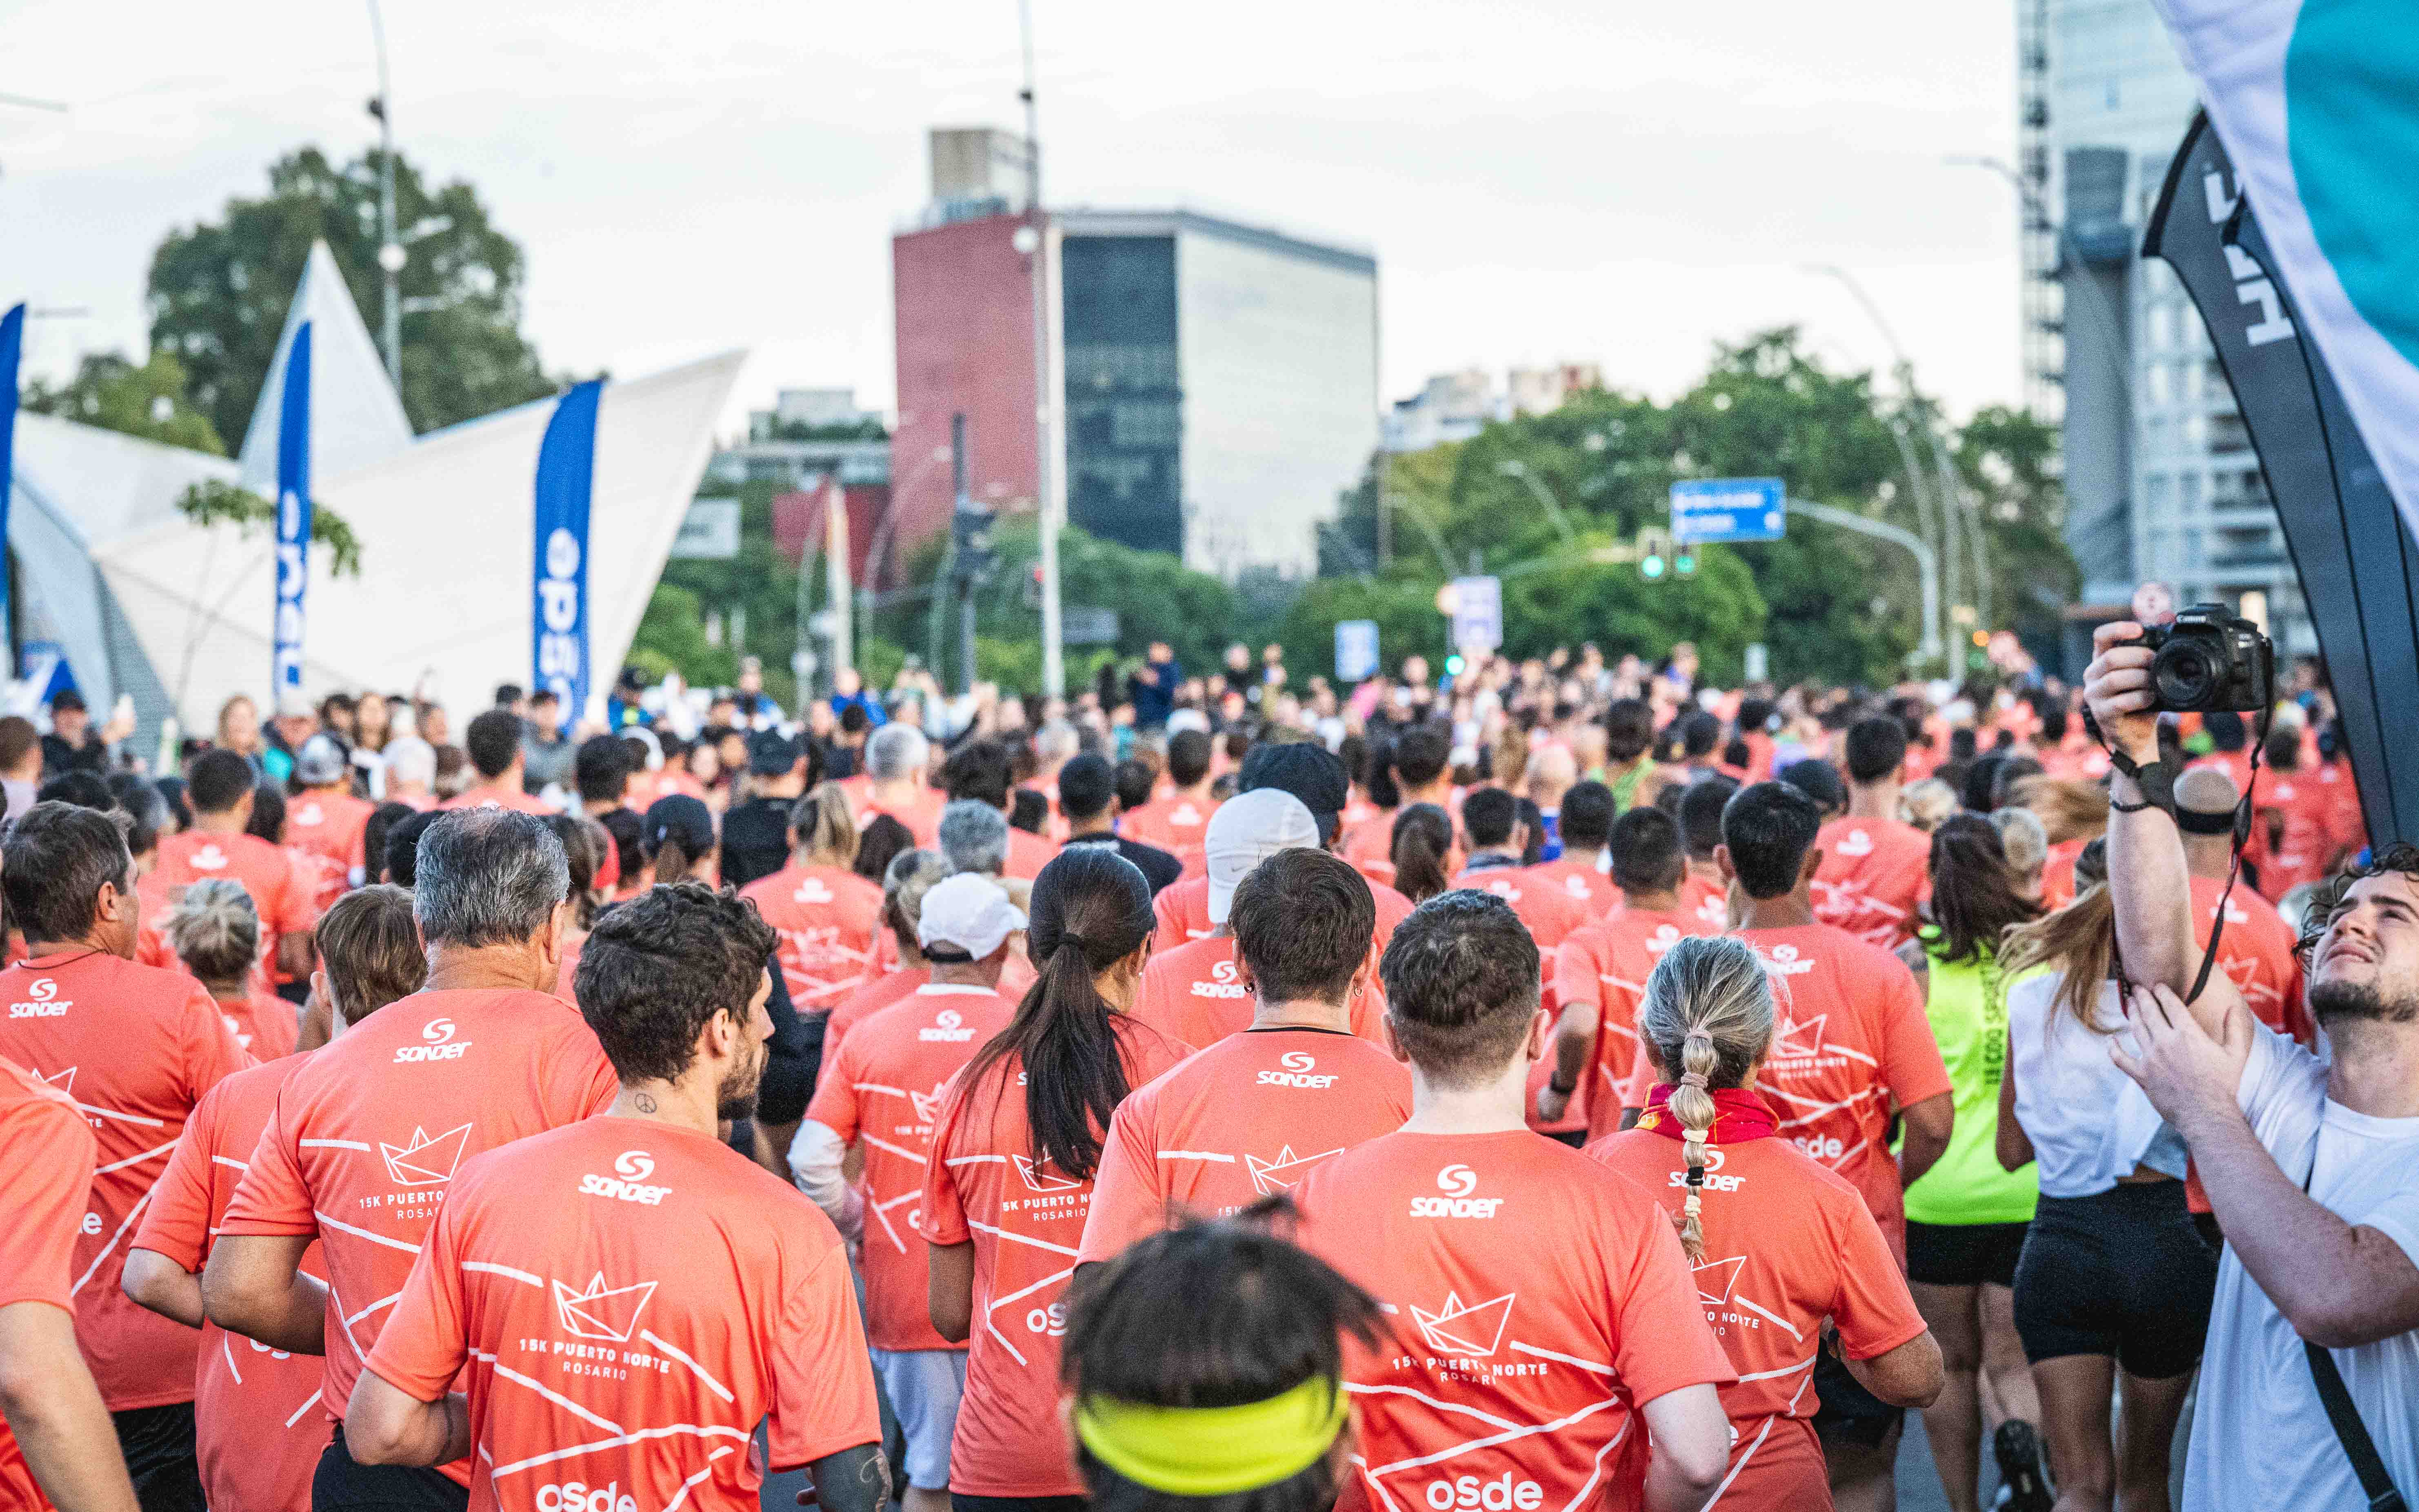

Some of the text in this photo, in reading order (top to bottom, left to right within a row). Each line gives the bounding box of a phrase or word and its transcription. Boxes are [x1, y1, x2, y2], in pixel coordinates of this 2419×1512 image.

[1190, 981, 1245, 999] SONDe
[1794, 1132, 1842, 1158] sde
[359, 1190, 444, 1209] 15K PUERTO
[1024, 1195, 1075, 1209] PUERTO
[397, 1207, 439, 1220] ROSA
[1033, 1208, 1086, 1221] ROSARIO
[1026, 1302, 1066, 1336] os
[519, 1339, 671, 1374] 15K PUERTO NORTE
[563, 1361, 627, 1381] ROSARIO
[1426, 1358, 1488, 1371] PUERT
[1492, 1363, 1548, 1377] NORTE
[1439, 1371, 1496, 1385] ROSARI
[536, 1480, 638, 1512] osde
[1426, 1471, 1544, 1510] osde
